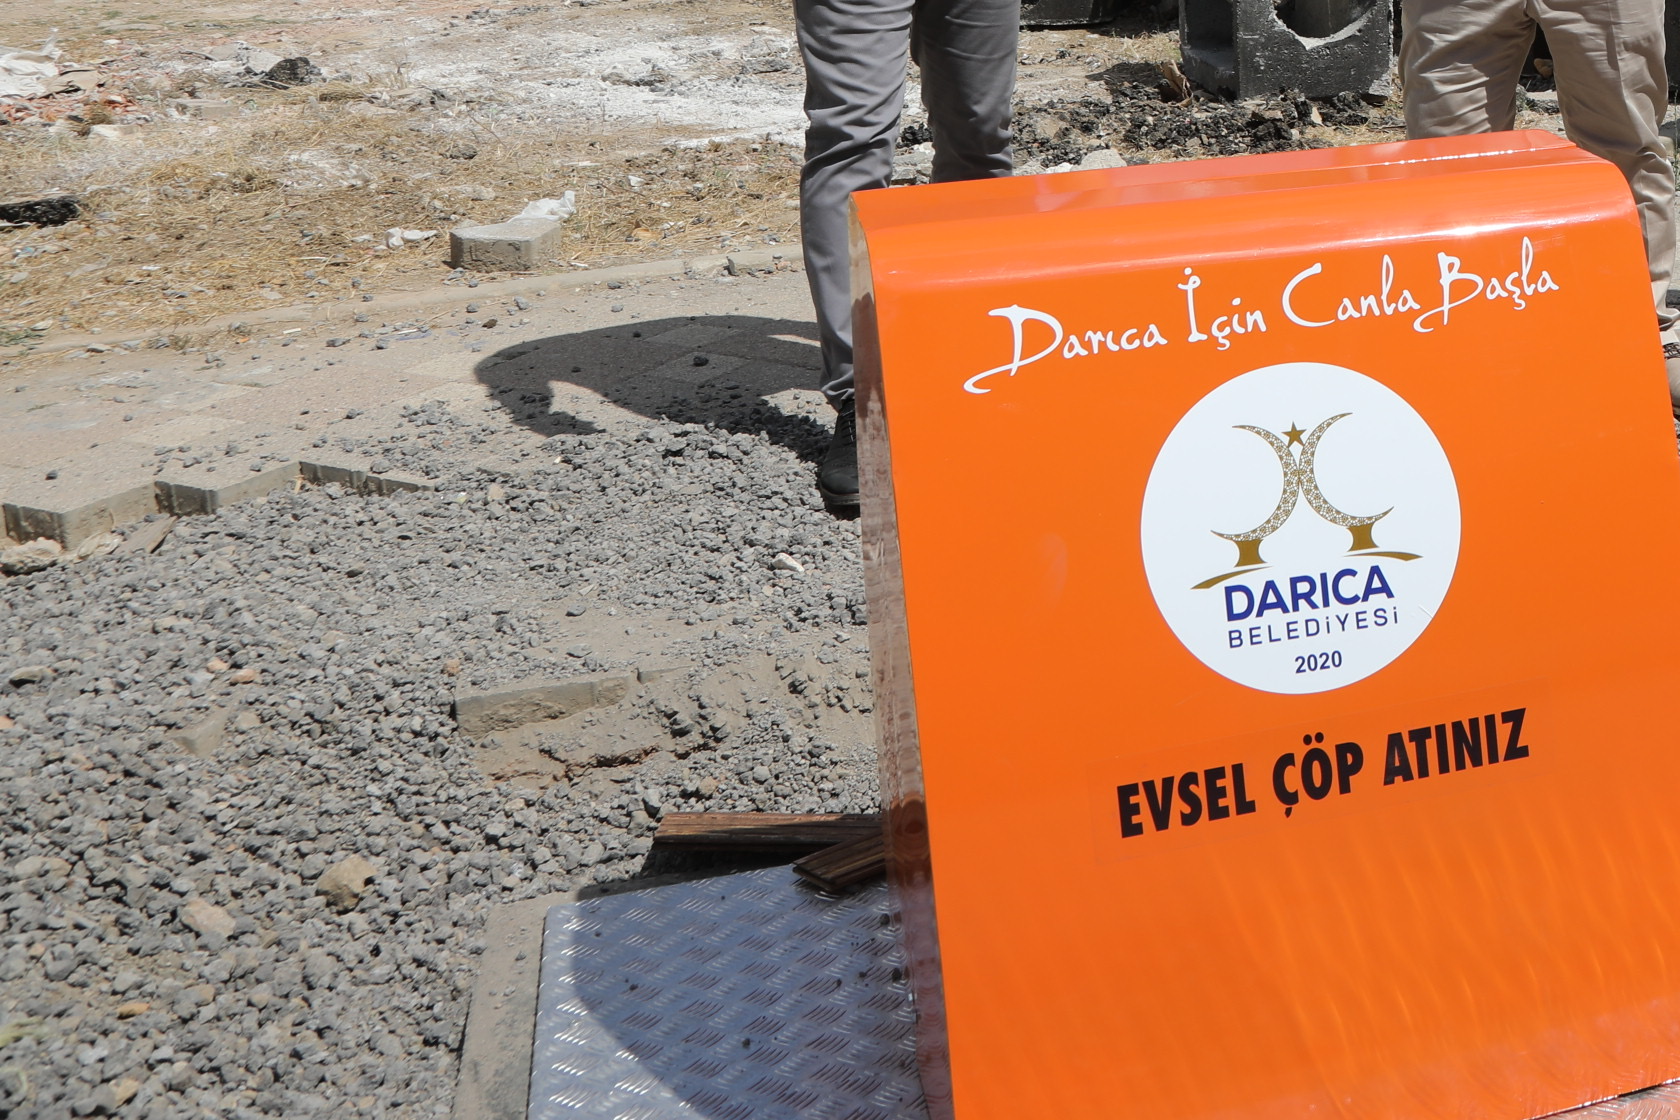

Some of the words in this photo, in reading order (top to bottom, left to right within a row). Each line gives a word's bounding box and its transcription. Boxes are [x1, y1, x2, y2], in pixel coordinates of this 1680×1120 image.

[963, 304, 1168, 394] Darıca
[1177, 267, 1267, 350] İçin
[1282, 254, 1421, 328] Canla
[1413, 236, 1560, 333] Başla
[1224, 565, 1395, 622] DARICA
[1294, 650, 1343, 675] 2020
[1116, 762, 1257, 839] EVSEL
[1271, 732, 1364, 818] ÇÖP
[1383, 707, 1530, 786] ATINIZ
